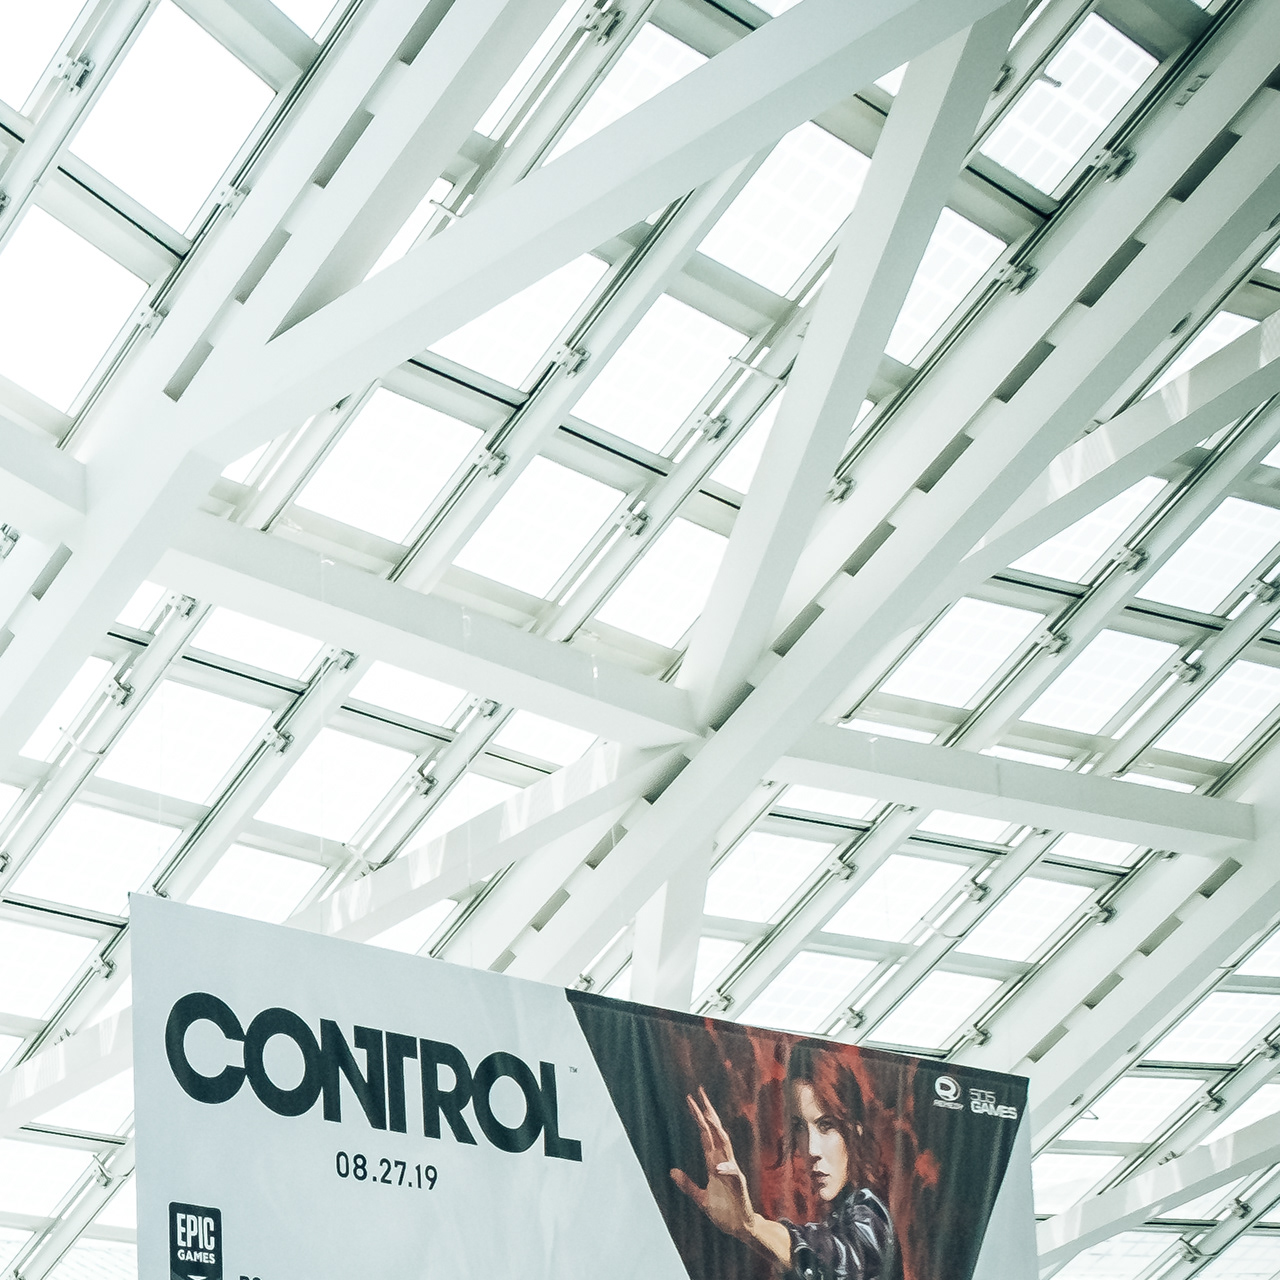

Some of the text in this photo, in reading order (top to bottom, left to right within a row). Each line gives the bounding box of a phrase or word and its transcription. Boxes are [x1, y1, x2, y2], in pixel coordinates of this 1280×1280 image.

[165, 991, 583, 1163] CONTROL
[970, 1101, 1017, 1119] GAMES
[336, 1151, 438, 1190] 08.27.19
[176, 1212, 215, 1250] EPIC
[177, 1249, 216, 1264] GAMES
